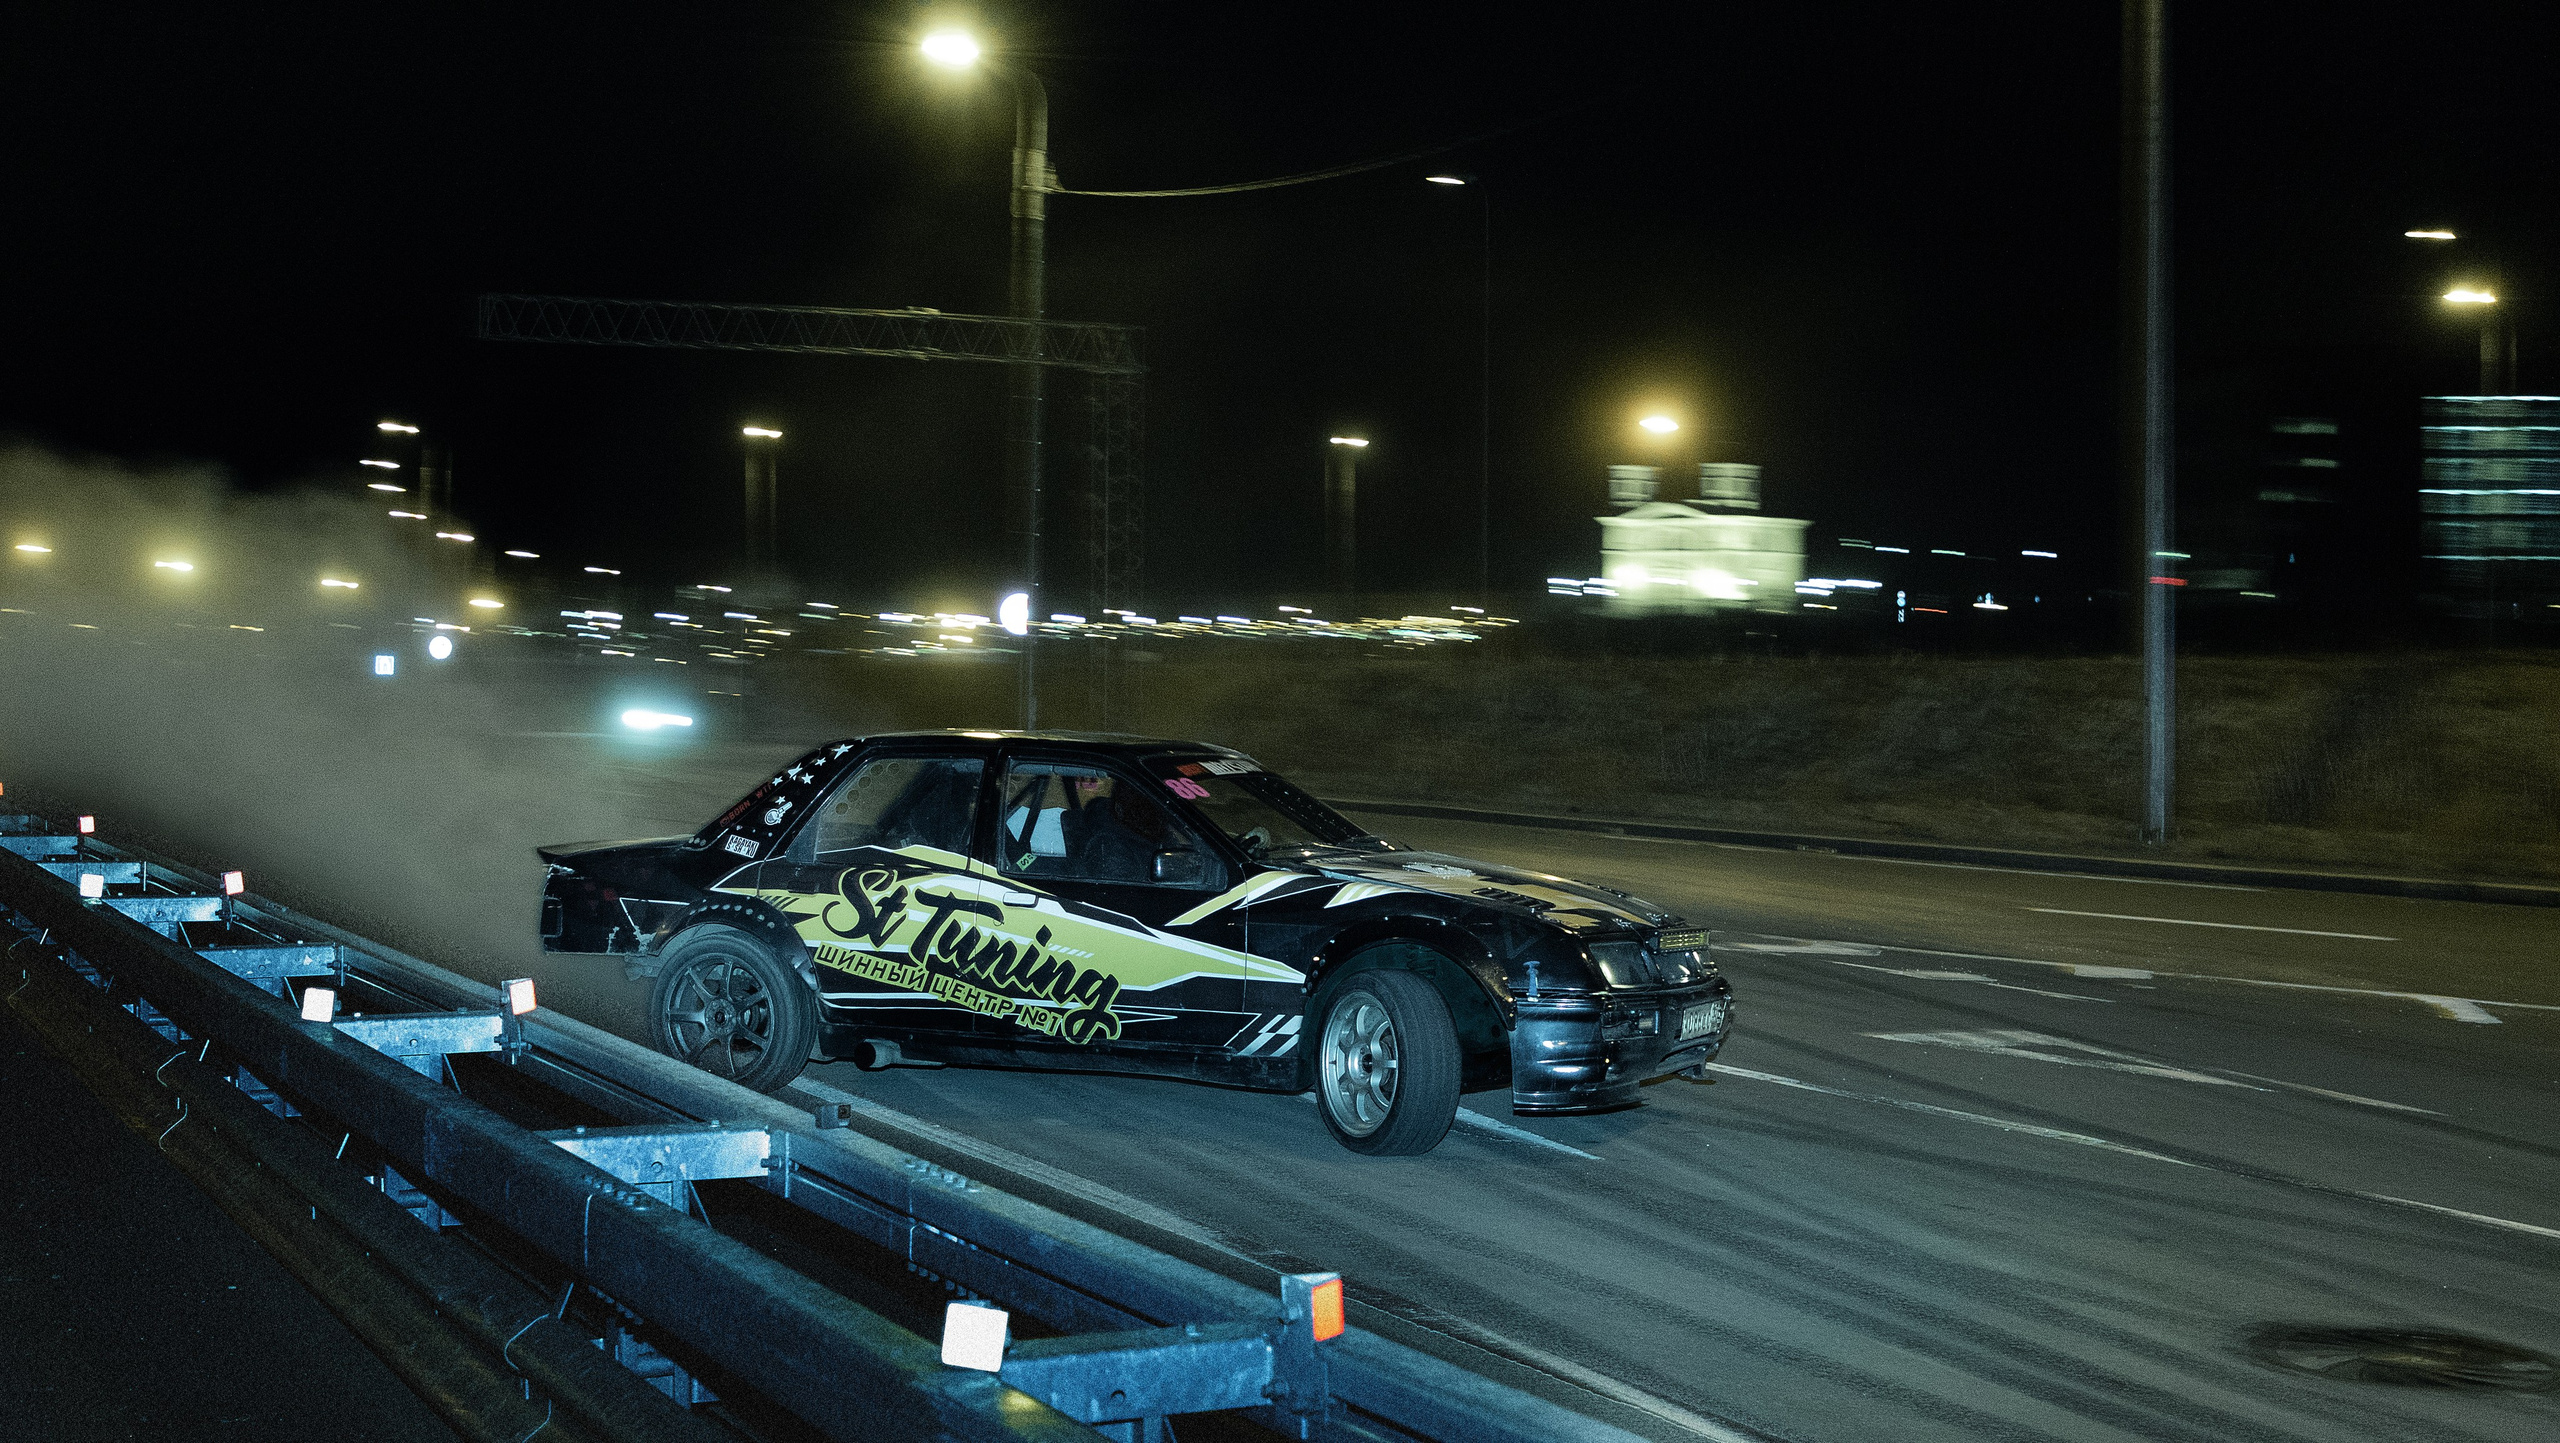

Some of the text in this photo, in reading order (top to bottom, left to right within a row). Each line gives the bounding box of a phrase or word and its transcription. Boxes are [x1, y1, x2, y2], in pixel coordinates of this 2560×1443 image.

[1165, 778, 1210, 799] 86
[815, 944, 928, 991] ШИННЫЙ
[929, 973, 1016, 1018] ЦЕНТР
[821, 867, 1121, 1044] St Tuning
